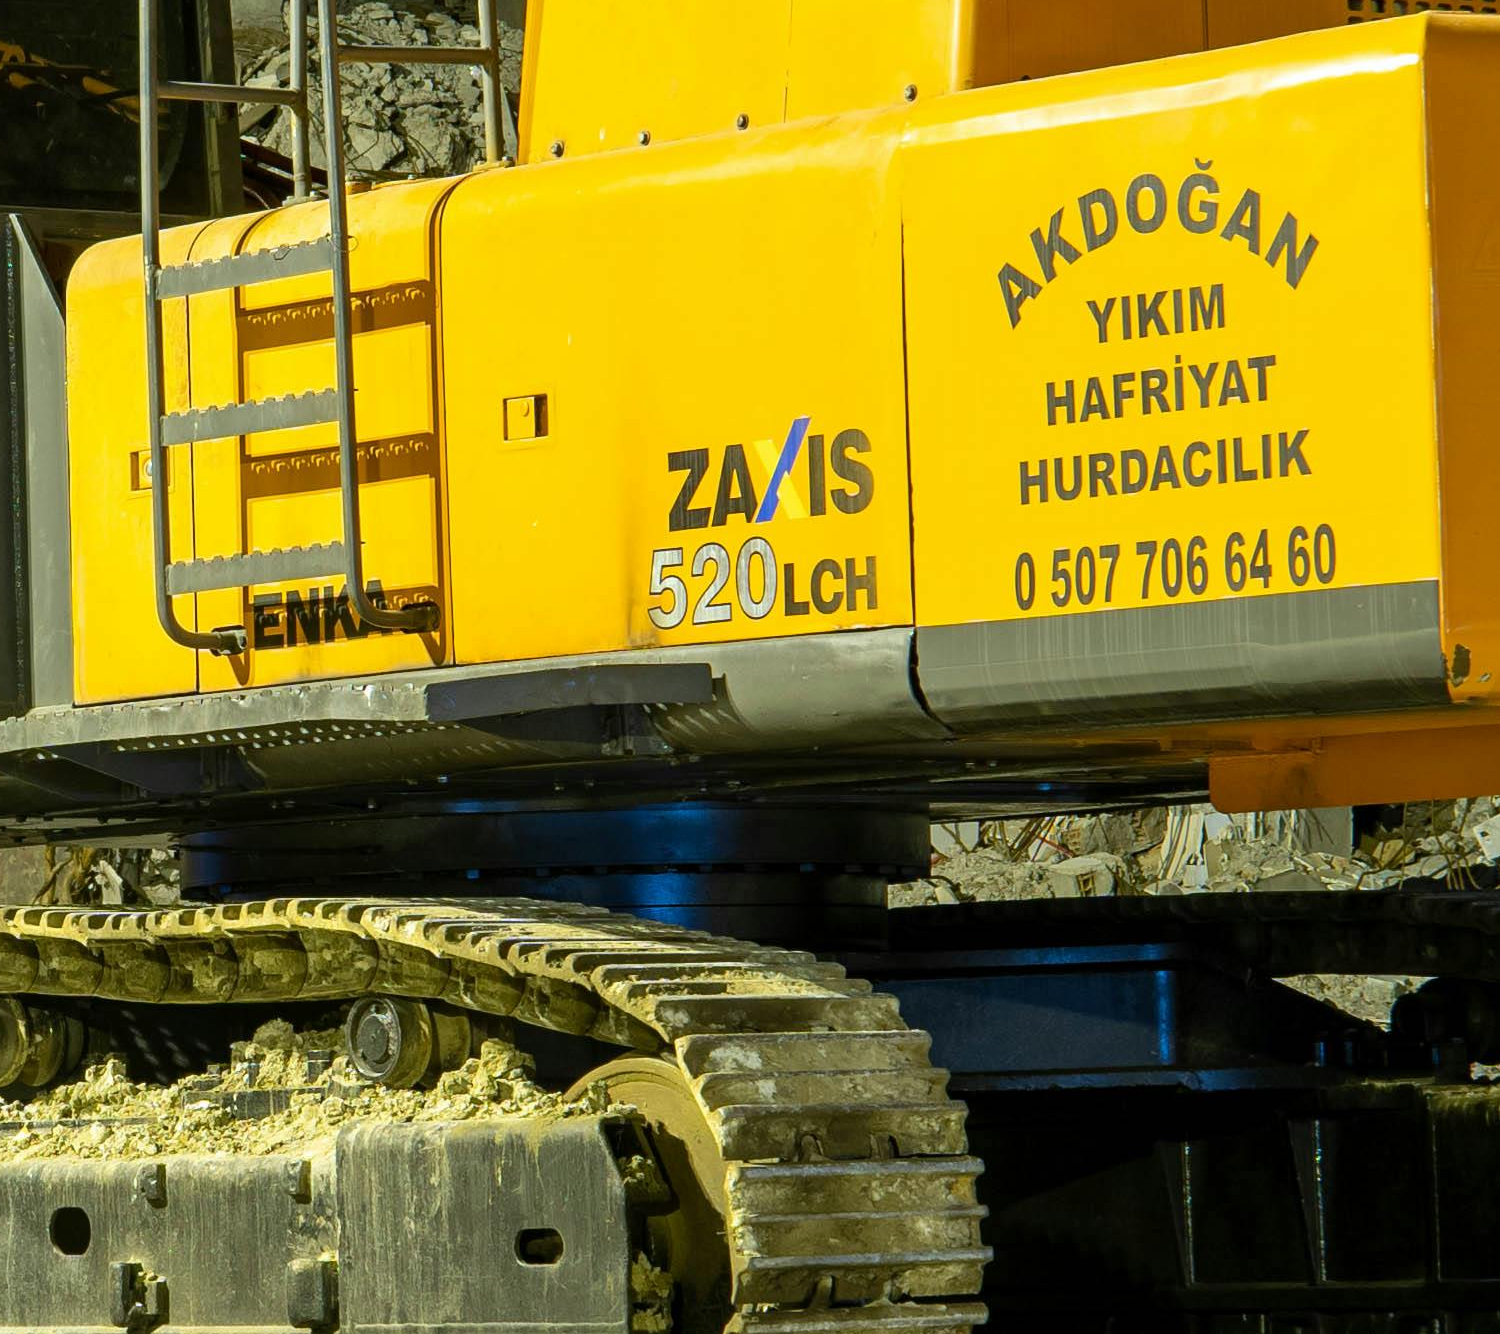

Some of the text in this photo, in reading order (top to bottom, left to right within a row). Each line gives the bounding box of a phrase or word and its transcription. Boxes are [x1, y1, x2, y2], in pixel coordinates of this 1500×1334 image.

[997, 157, 1319, 330] AKDOĞAN
[1086, 283, 1226, 344] YIKIM
[1045, 354, 1277, 426] HAFRİYAT
[667, 415, 875, 533] ZAXIS
[1019, 429, 1312, 506] HURDACILIK
[1015, 523, 1336, 611] 0 507 706 64 60
